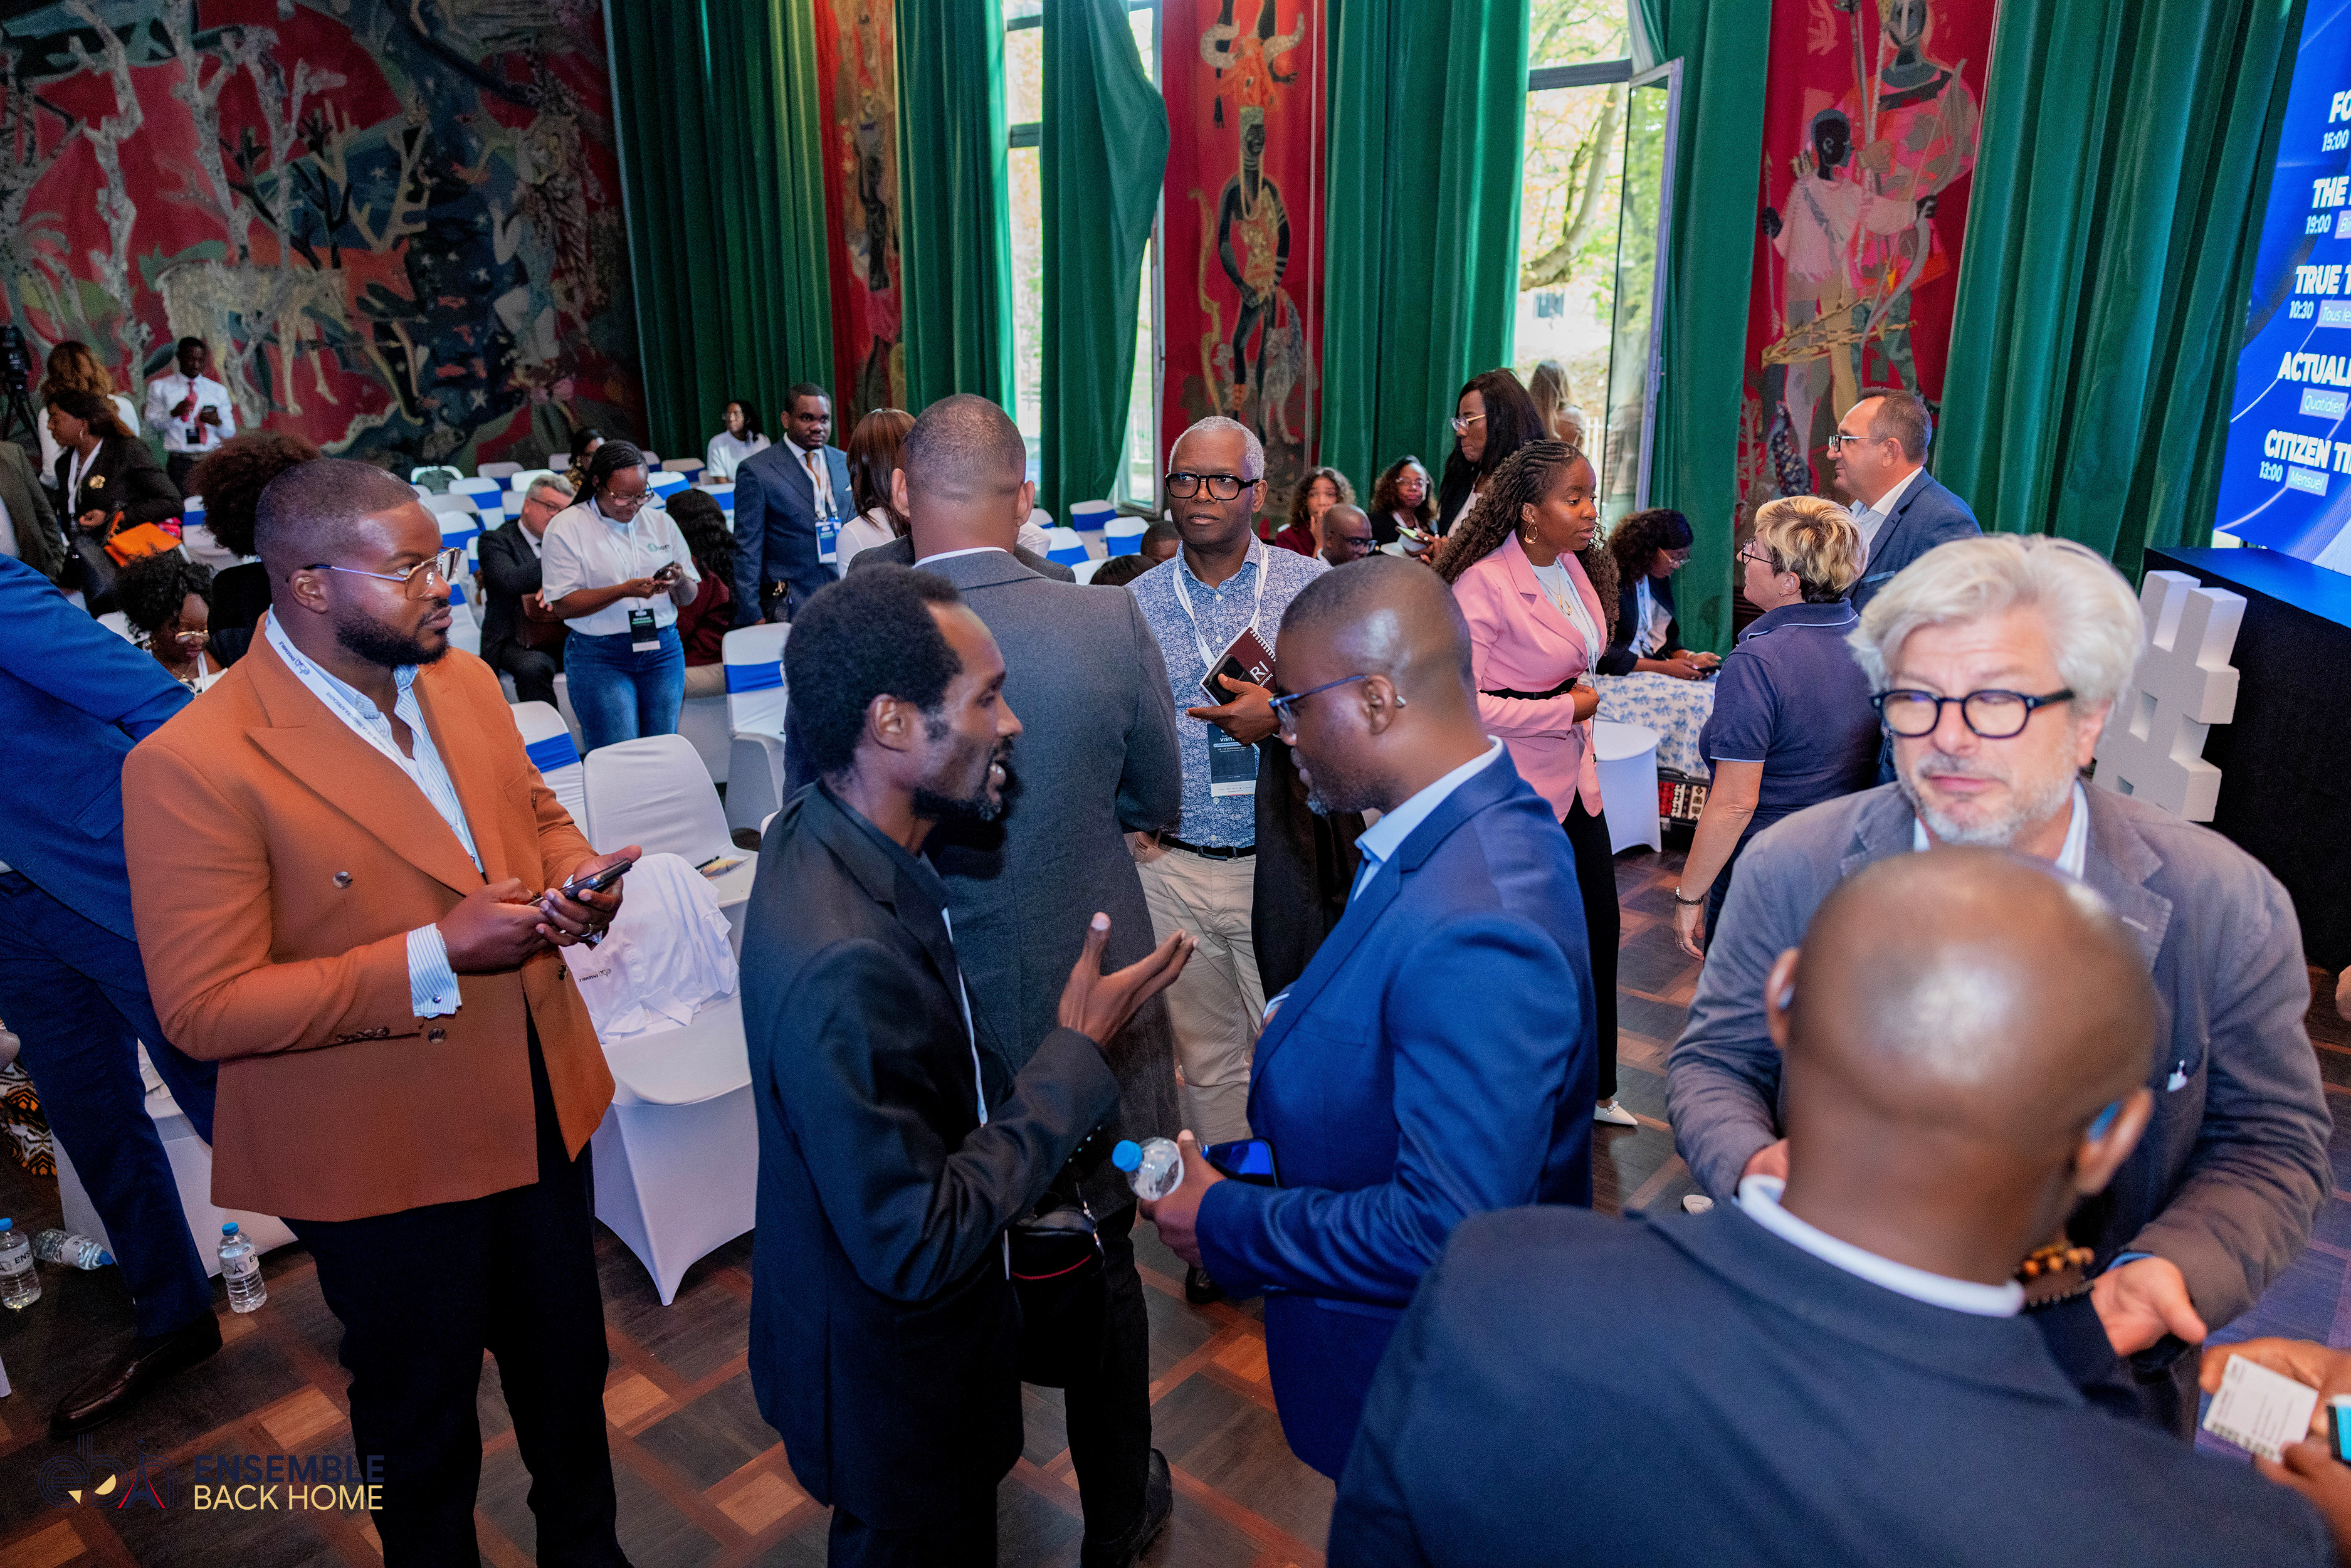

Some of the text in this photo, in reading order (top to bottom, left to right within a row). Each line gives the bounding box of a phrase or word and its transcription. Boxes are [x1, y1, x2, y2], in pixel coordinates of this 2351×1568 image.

[2322, 129, 2350, 152] 15:00
[2312, 176, 2350, 208] THE
[2305, 214, 2332, 234] 19:00
[2295, 265, 2343, 295] TRUE
[2289, 300, 2315, 319] 10:30
[2322, 307, 2342, 322] Tous
[2304, 395, 2345, 414] Quotidien
[2264, 429, 2351, 475] CITIZEN TI
[2259, 461, 2283, 482] 13:00
[2290, 471, 2325, 490] Mensuel
[278, 640, 296, 661] ENSEMBLE
